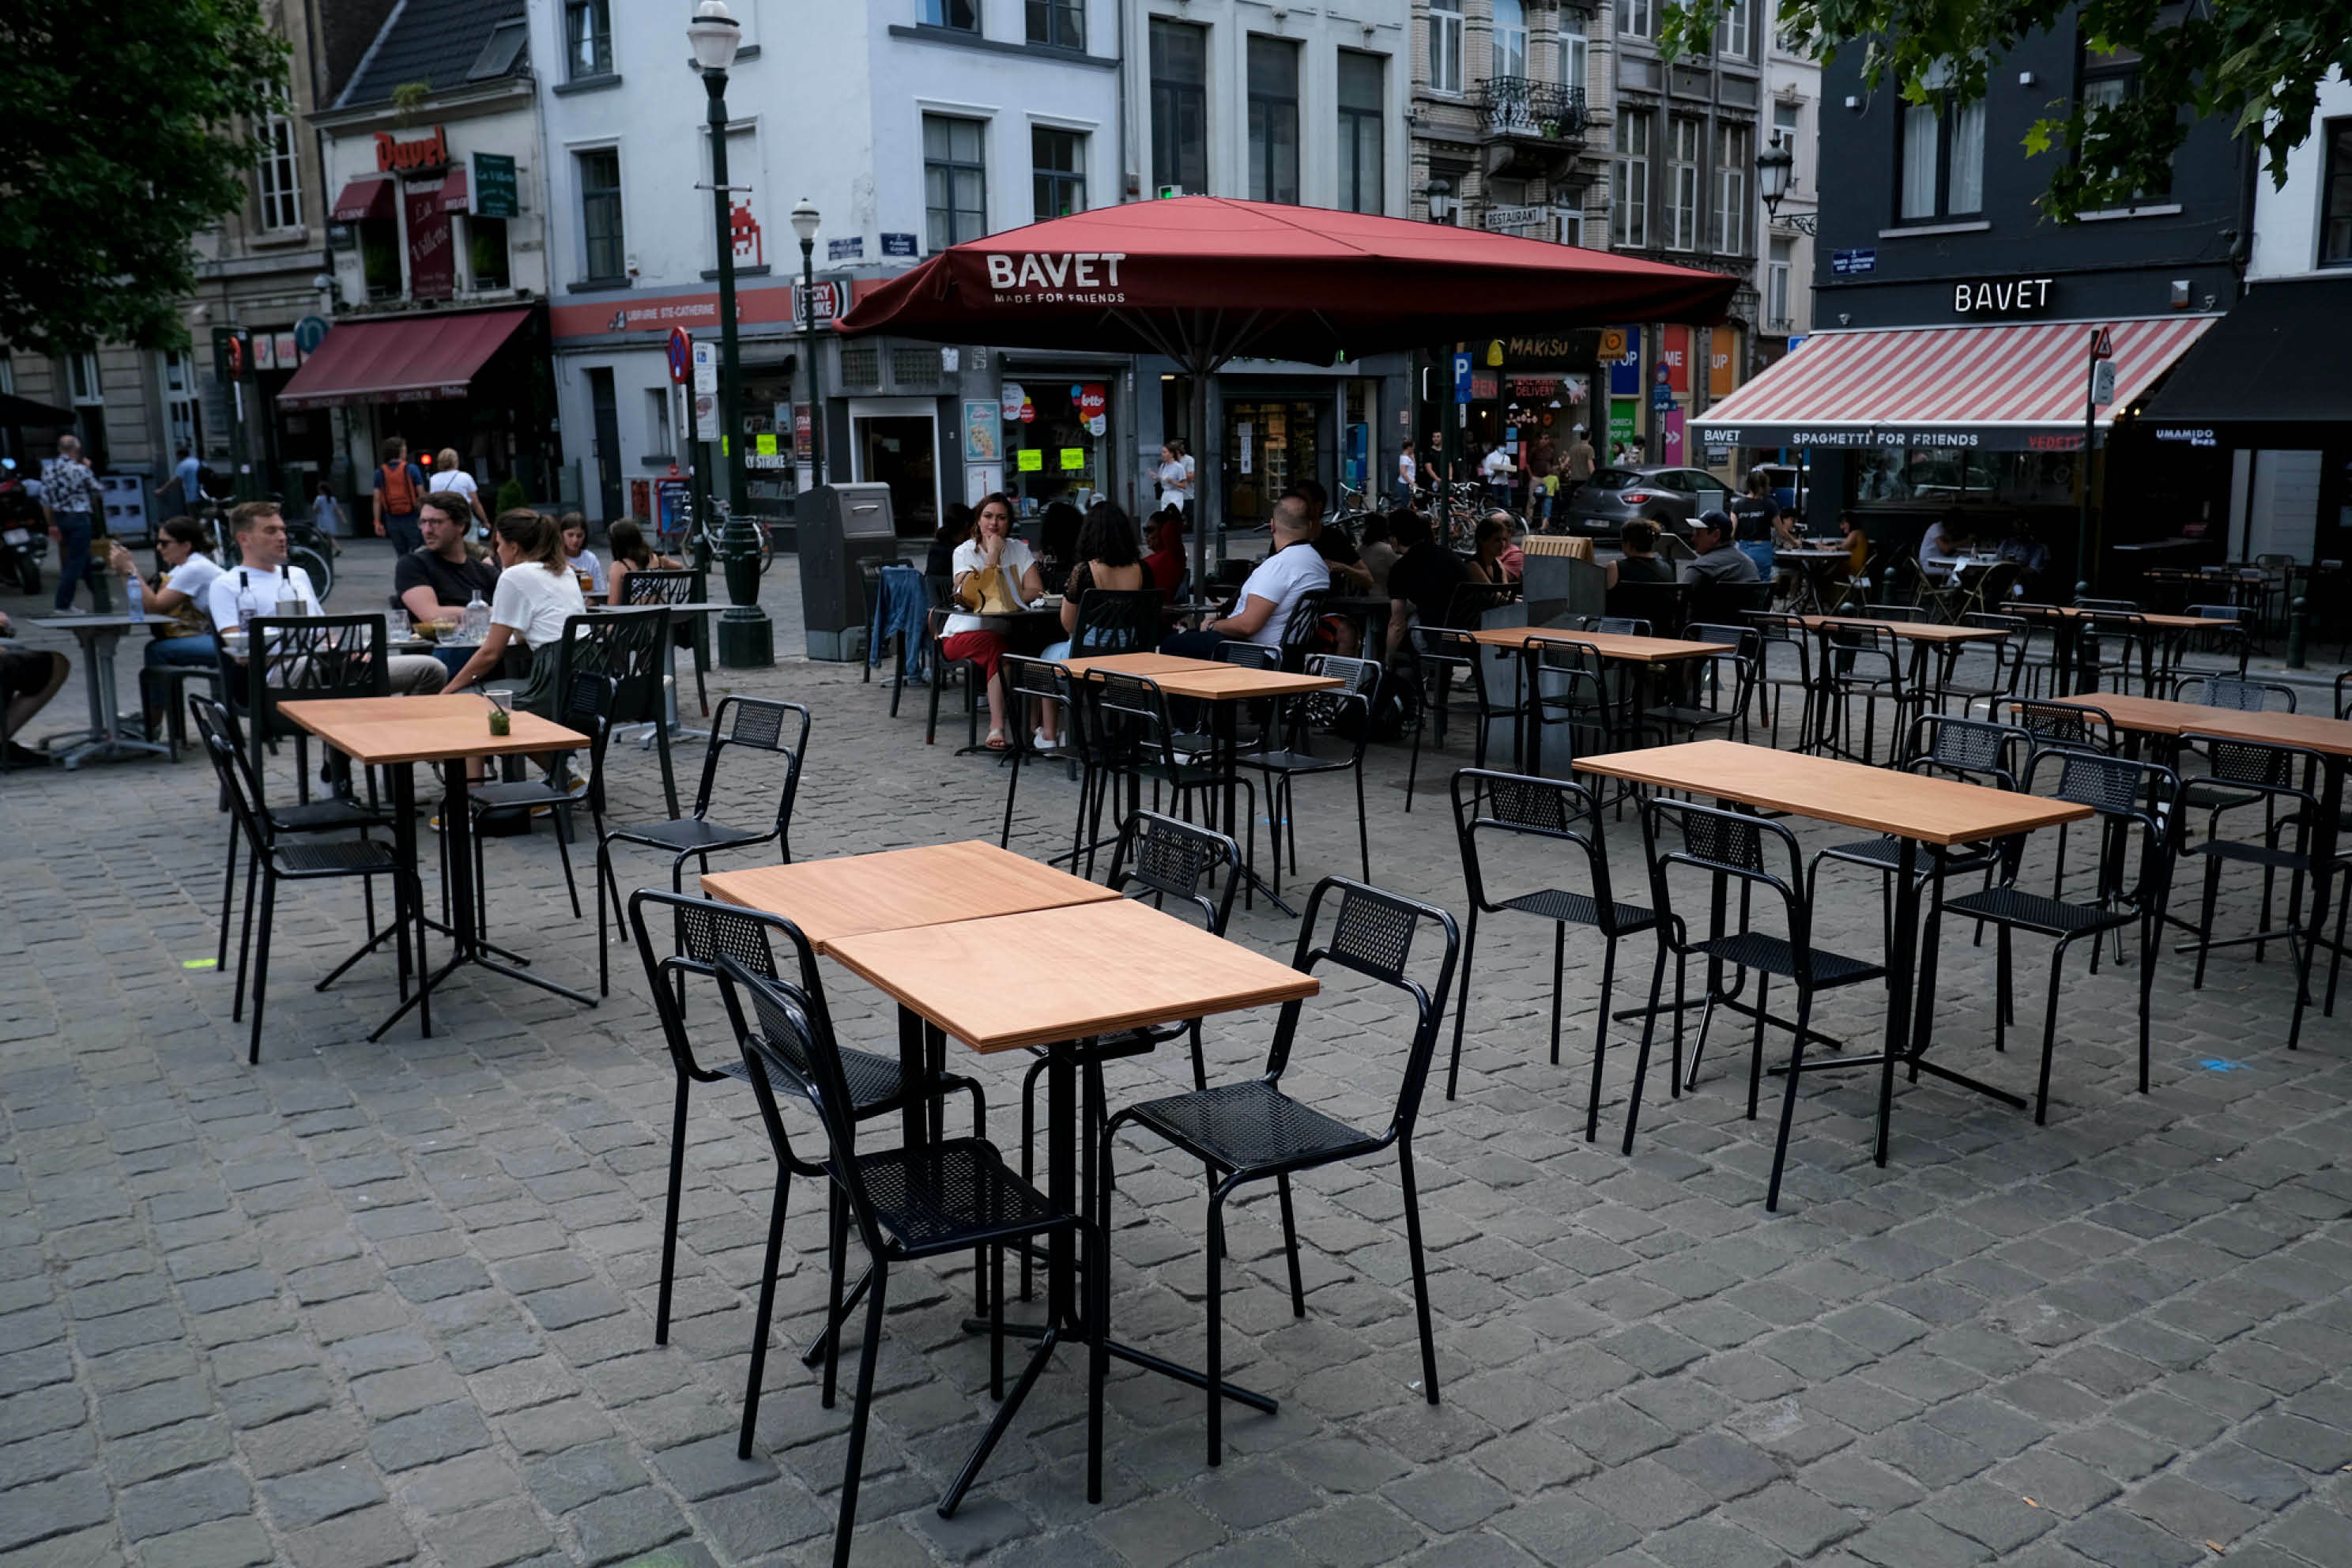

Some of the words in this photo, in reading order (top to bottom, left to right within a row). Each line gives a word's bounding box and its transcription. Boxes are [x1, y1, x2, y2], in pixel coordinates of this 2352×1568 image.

[374, 124, 447, 172] Duvel
[1488, 209, 1537, 224] RESTAURANT
[986, 253, 1126, 288] BAVET
[994, 293, 1031, 304] MADE
[1037, 293, 1064, 303] FOR
[1068, 292, 1125, 303] FRIENDS
[1955, 279, 2052, 312] BAVET
[1665, 351, 1683, 367] ME
[1713, 353, 1728, 369] UP
[1456, 358, 1468, 384] P
[1472, 379, 1498, 397] PEN
[1516, 386, 1556, 397] DELIVERY
[1081, 394, 1105, 407] lotto
[1704, 429, 1740, 442] BAVET
[1792, 432, 1871, 444] SPAGHETTI
[1877, 432, 1905, 444] FOR
[1912, 433, 1979, 446] FRIENDS
[2156, 428, 2214, 439] UMAMIDO
[2028, 436, 2082, 450] VEDETT
